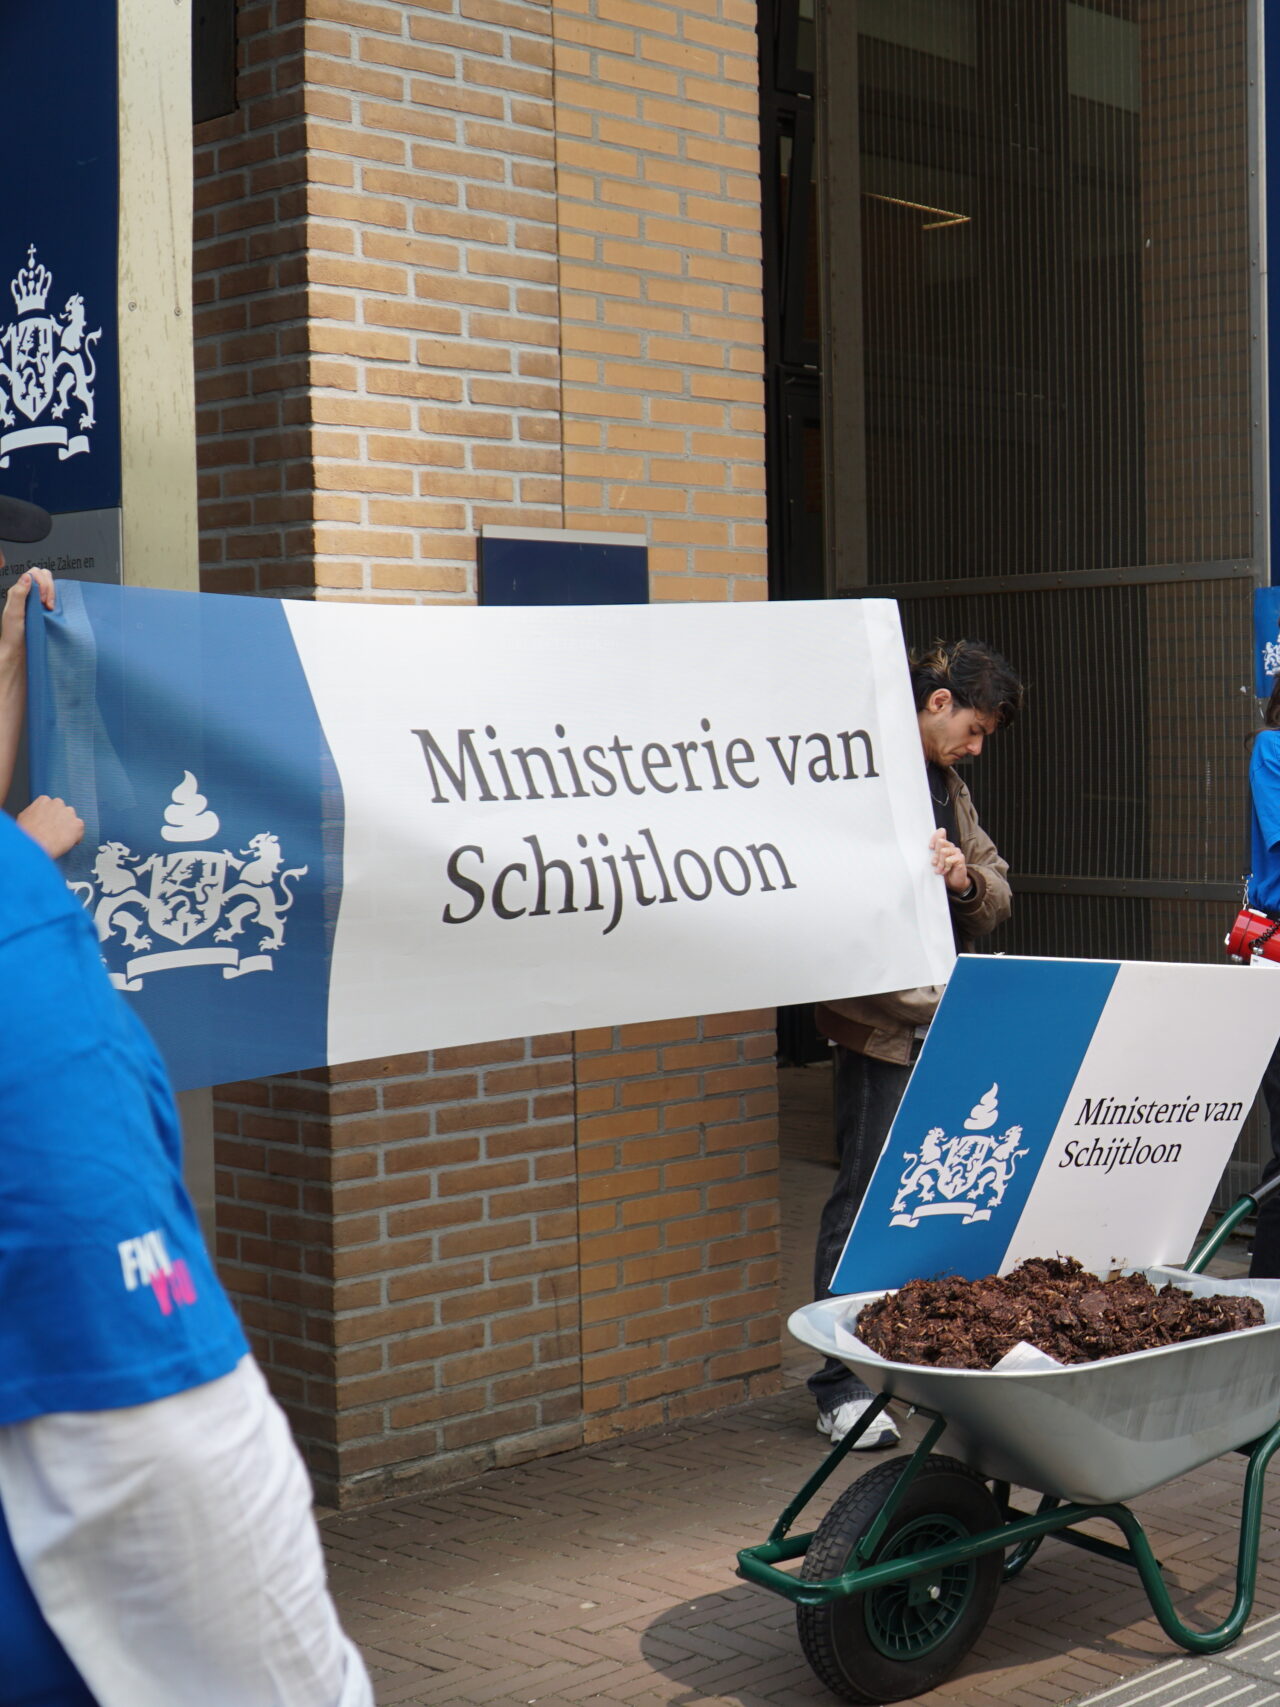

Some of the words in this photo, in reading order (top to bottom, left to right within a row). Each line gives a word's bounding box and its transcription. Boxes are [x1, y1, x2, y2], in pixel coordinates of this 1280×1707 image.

[10, 564, 25, 575] van
[56, 555, 82, 571] Zaken
[83, 557, 95, 568] en
[411, 718, 760, 804] Ministerie
[766, 726, 880, 785] van
[442, 828, 797, 935] Schijtloon
[1075, 1095, 1201, 1126] Ministerie
[1204, 1101, 1243, 1122] van
[1058, 1136, 1183, 1175] Schijtloon
